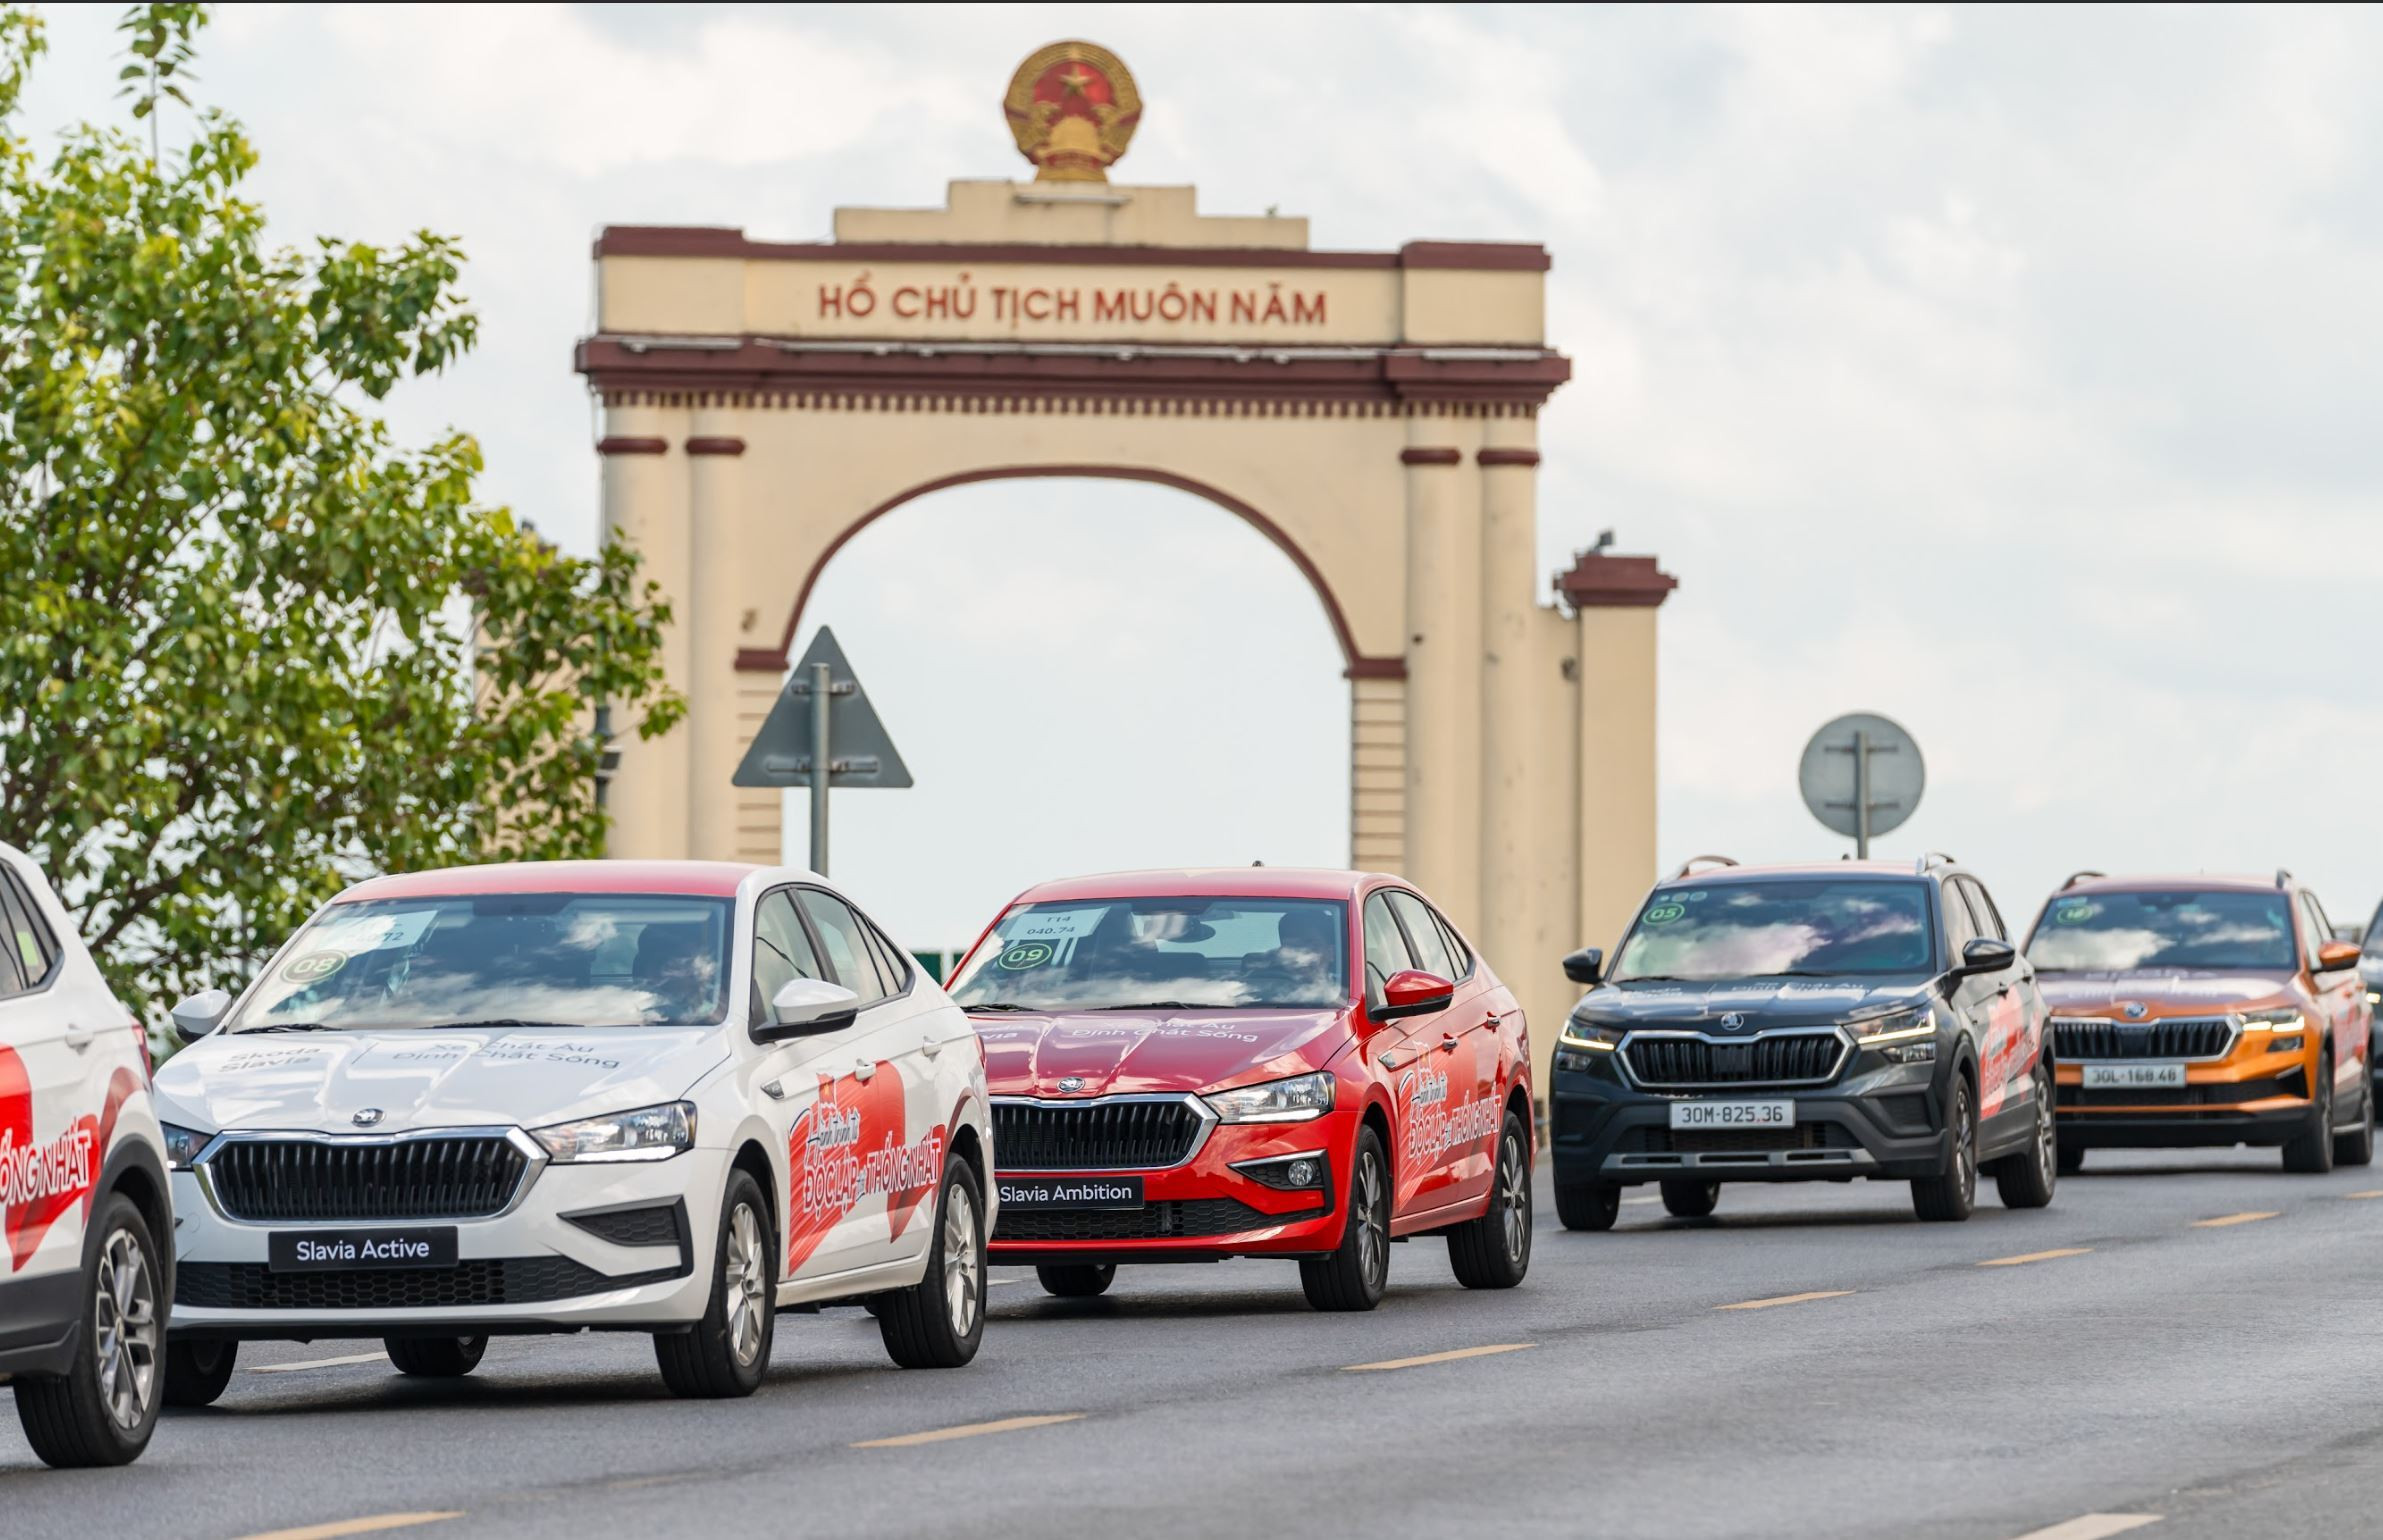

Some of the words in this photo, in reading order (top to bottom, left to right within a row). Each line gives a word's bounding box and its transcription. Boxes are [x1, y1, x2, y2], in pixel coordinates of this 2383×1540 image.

[892, 271, 977, 320] CHỦ
[991, 287, 1080, 330] TỊCH
[1094, 281, 1217, 324] MUÔN
[1231, 281, 1327, 325] NĂM
[1650, 907, 1678, 920] 05
[1007, 948, 1044, 962] 09
[293, 956, 338, 974] 08
[218, 1056, 311, 1073] Slavia
[1681, 1105, 1784, 1124] 30M-825.36
[38, 1114, 92, 1198] NHẤT
[866, 1130, 909, 1195] THỐNG
[907, 1125, 942, 1188] NHẤT
[1000, 1185, 1049, 1202] Slavia
[1052, 1183, 1132, 1201] Ambition
[296, 1239, 356, 1262] Slavia
[360, 1237, 430, 1260] Active
